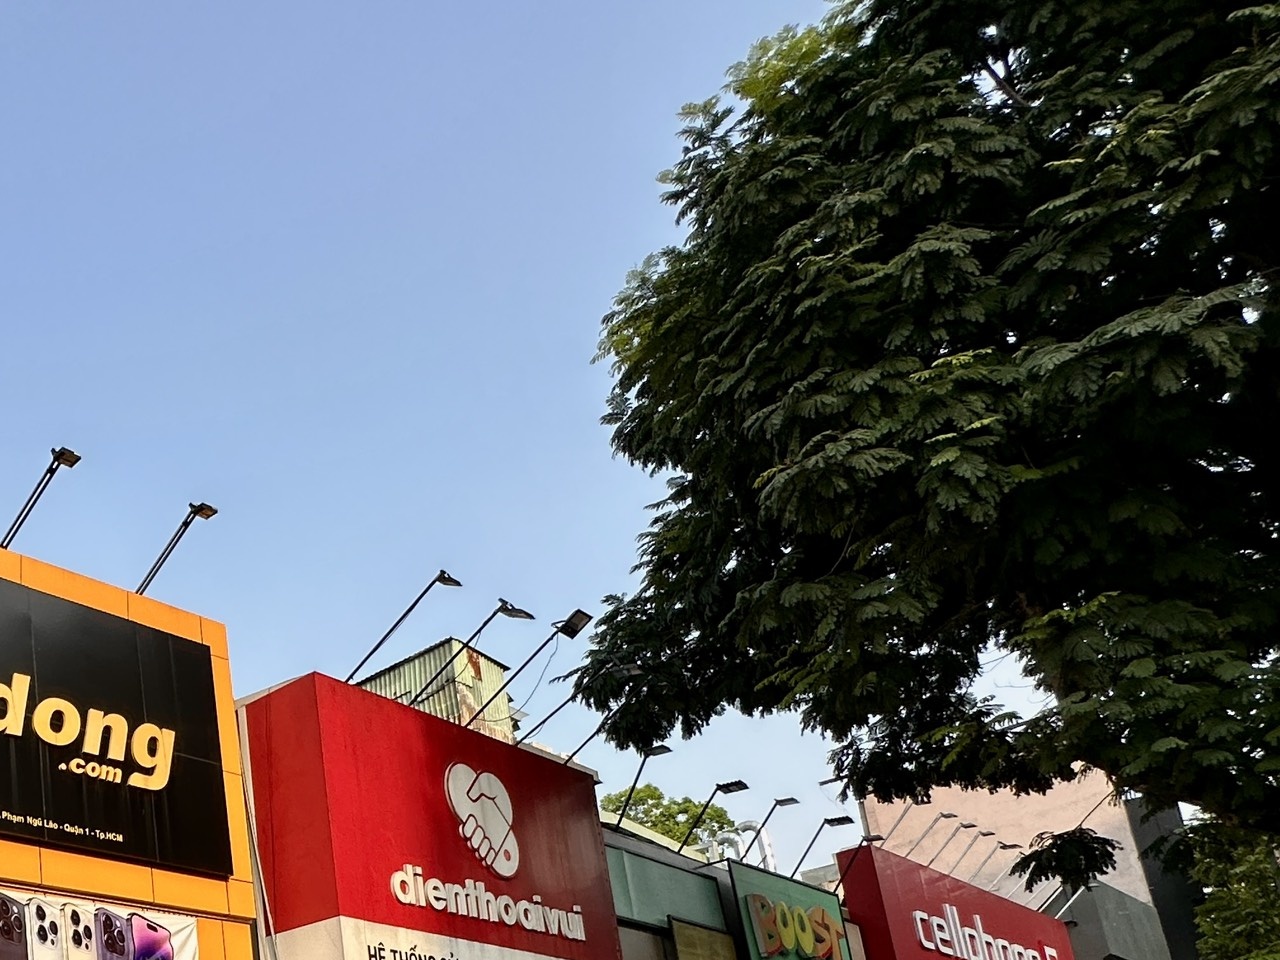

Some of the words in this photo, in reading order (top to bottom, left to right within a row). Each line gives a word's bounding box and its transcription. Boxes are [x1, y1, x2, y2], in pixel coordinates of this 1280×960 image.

[58, 757, 122, 784] .com
[27, 816, 43, 827] Ngũ
[63, 823, 84, 836] Quận
[391, 864, 586, 941] dienthoaivui
